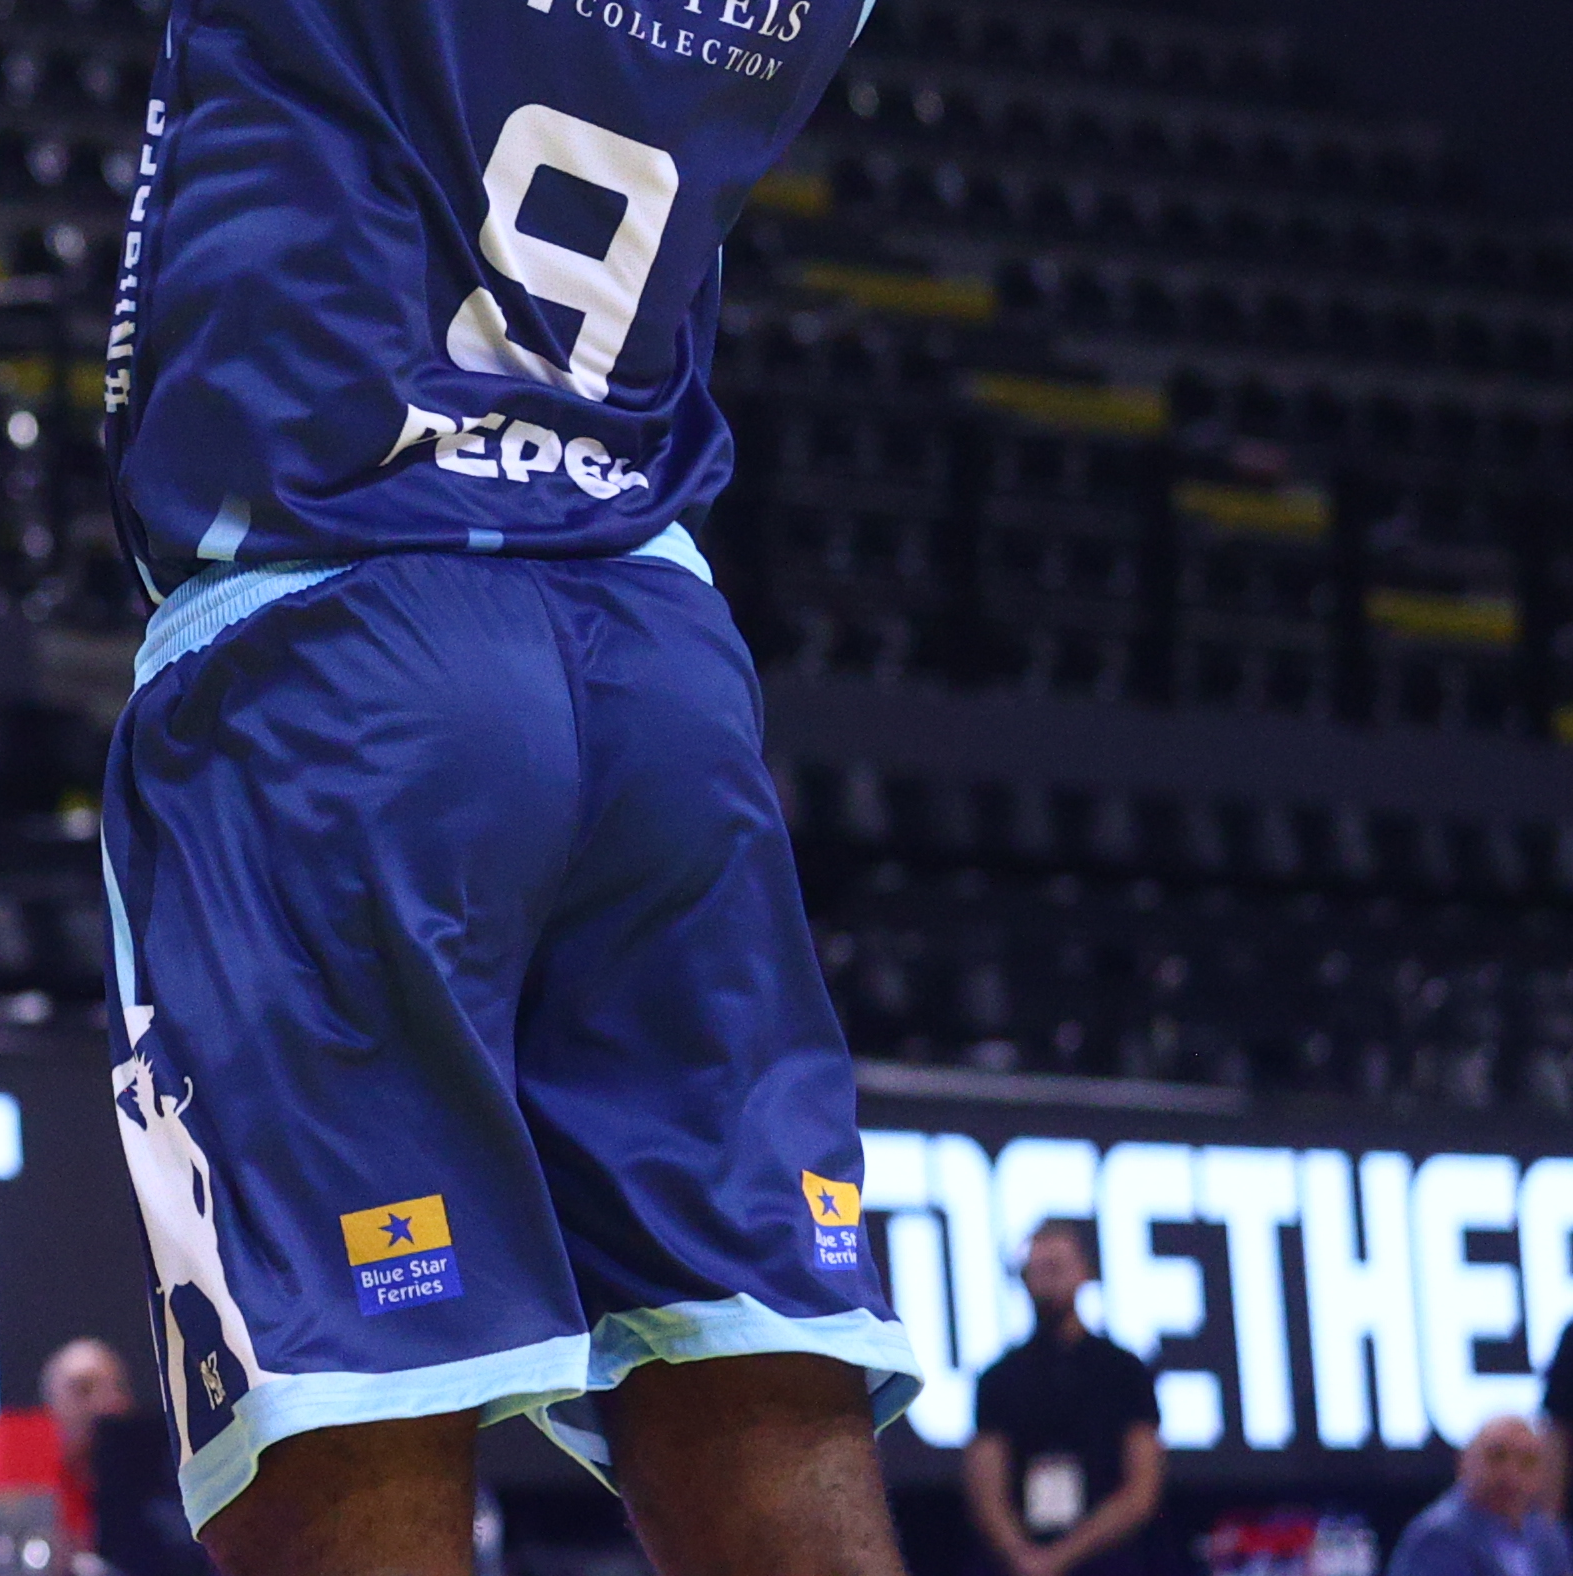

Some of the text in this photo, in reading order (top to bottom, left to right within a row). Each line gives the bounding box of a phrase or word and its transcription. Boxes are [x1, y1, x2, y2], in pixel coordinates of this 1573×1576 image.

[446, 104, 680, 402] 9
[360, 1258, 448, 1289] Blue Star
[376, 1279, 444, 1305] Ferries
